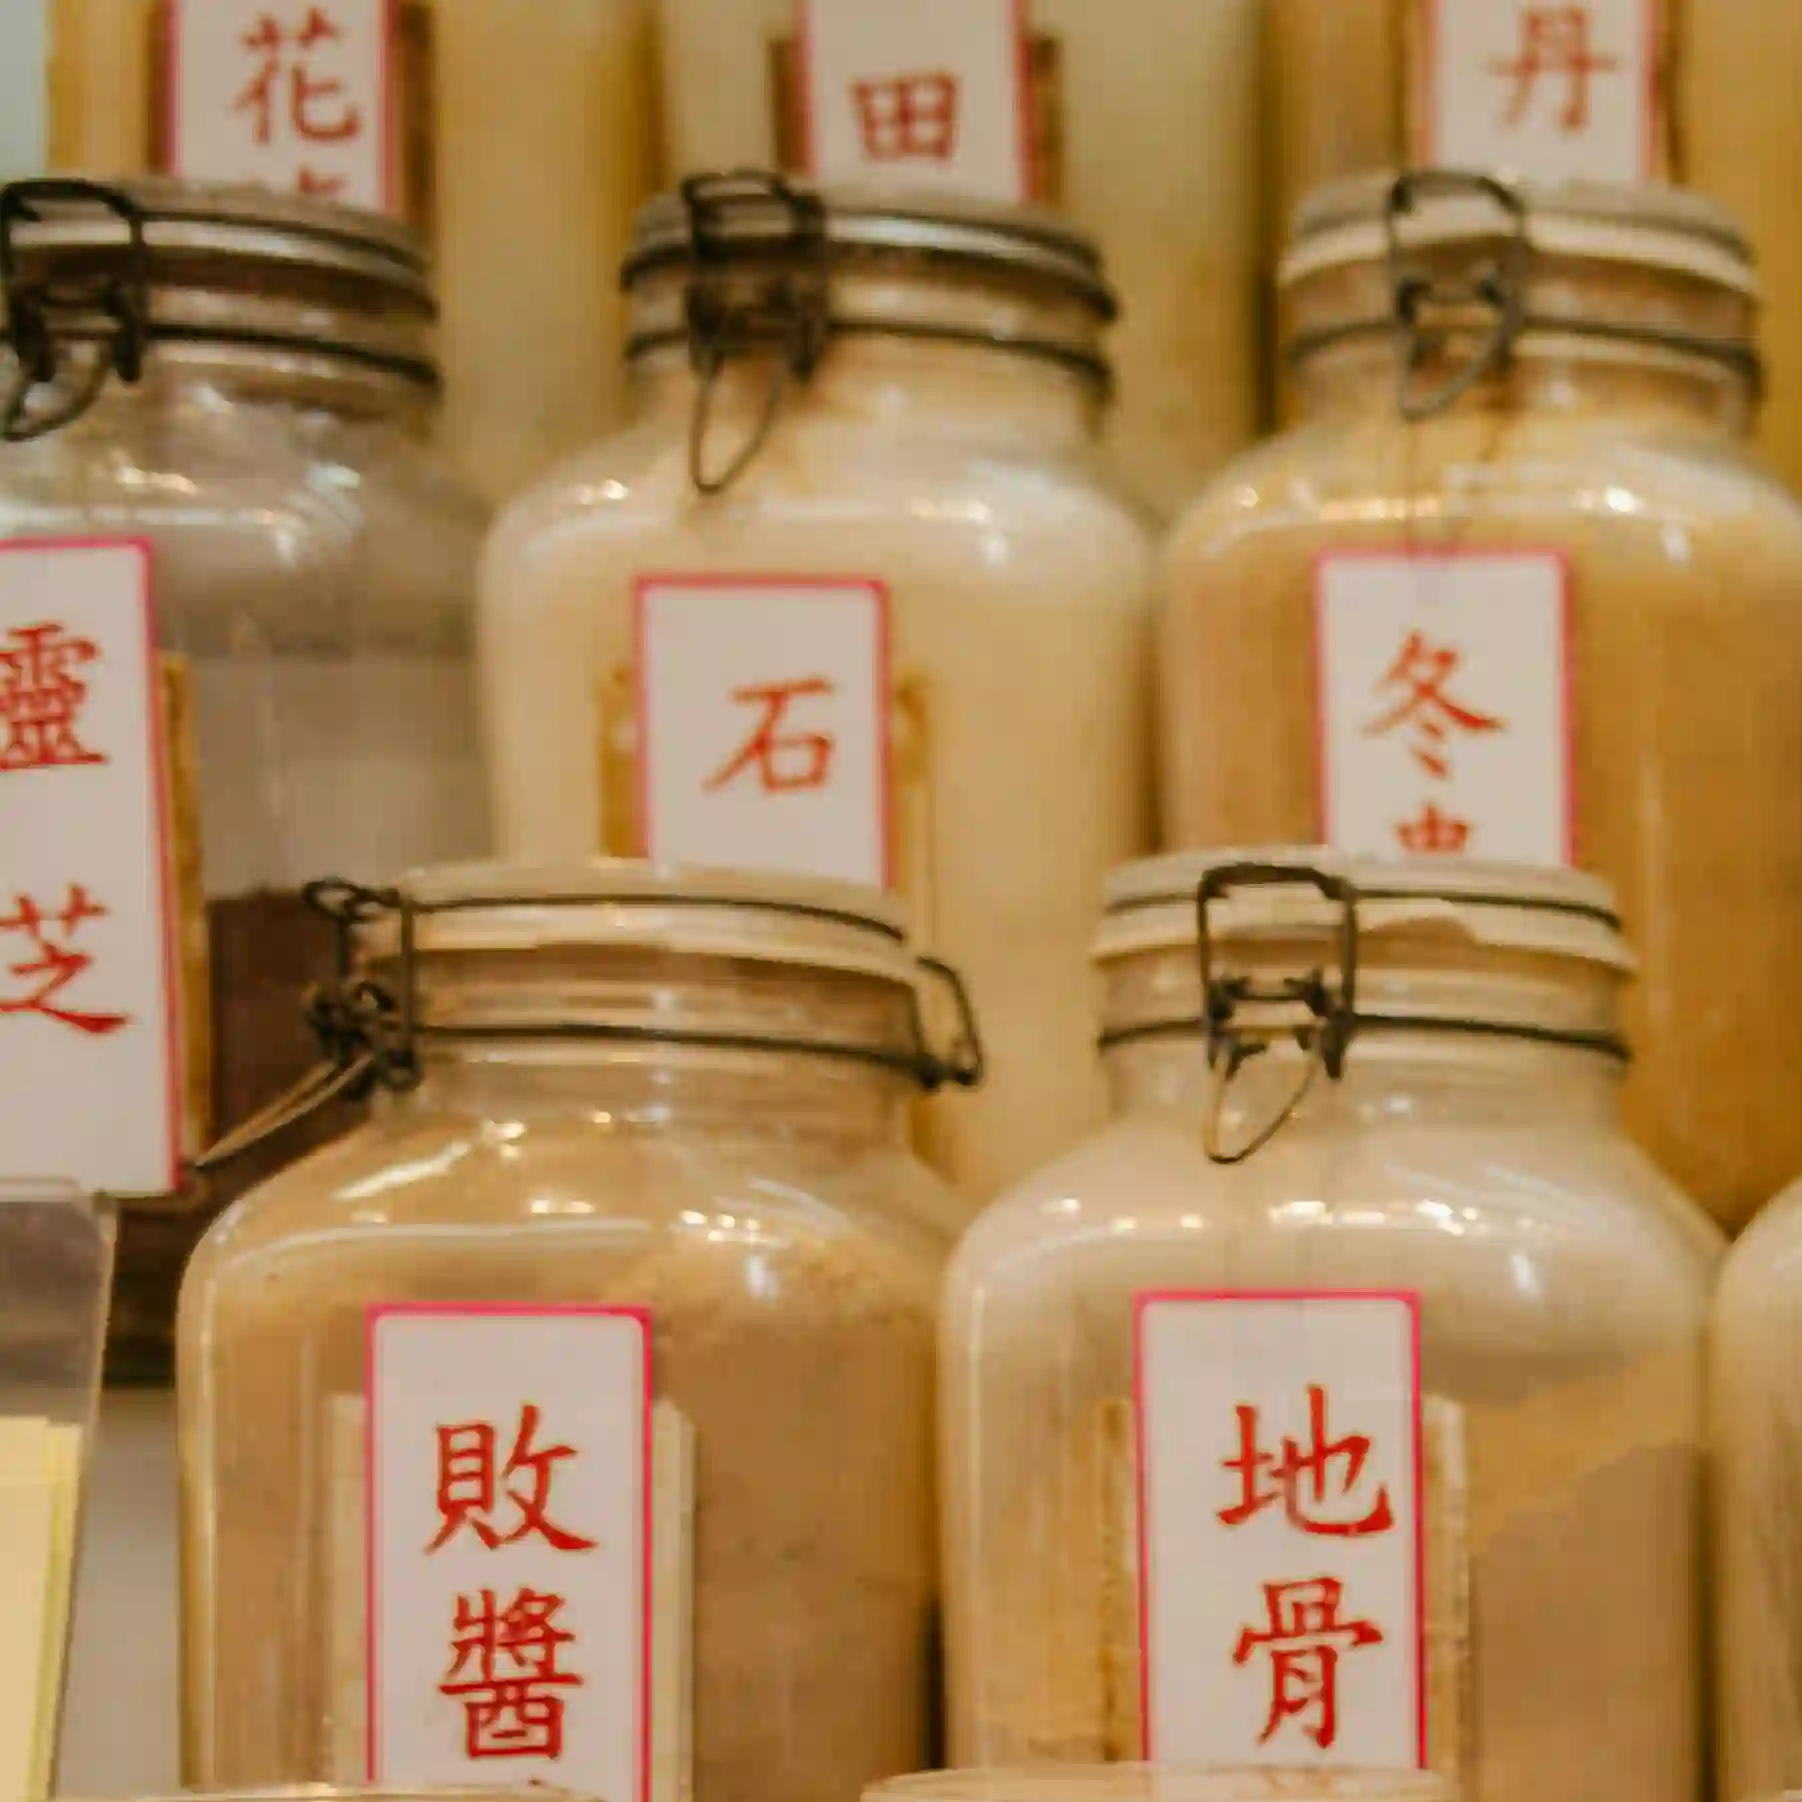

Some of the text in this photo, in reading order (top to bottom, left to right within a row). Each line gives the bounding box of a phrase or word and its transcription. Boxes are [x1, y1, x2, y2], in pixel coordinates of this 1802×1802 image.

[234, 9, 362, 196] 花
[706, 678, 836, 794] 石
[1219, 1387, 1393, 1748] 地骨
